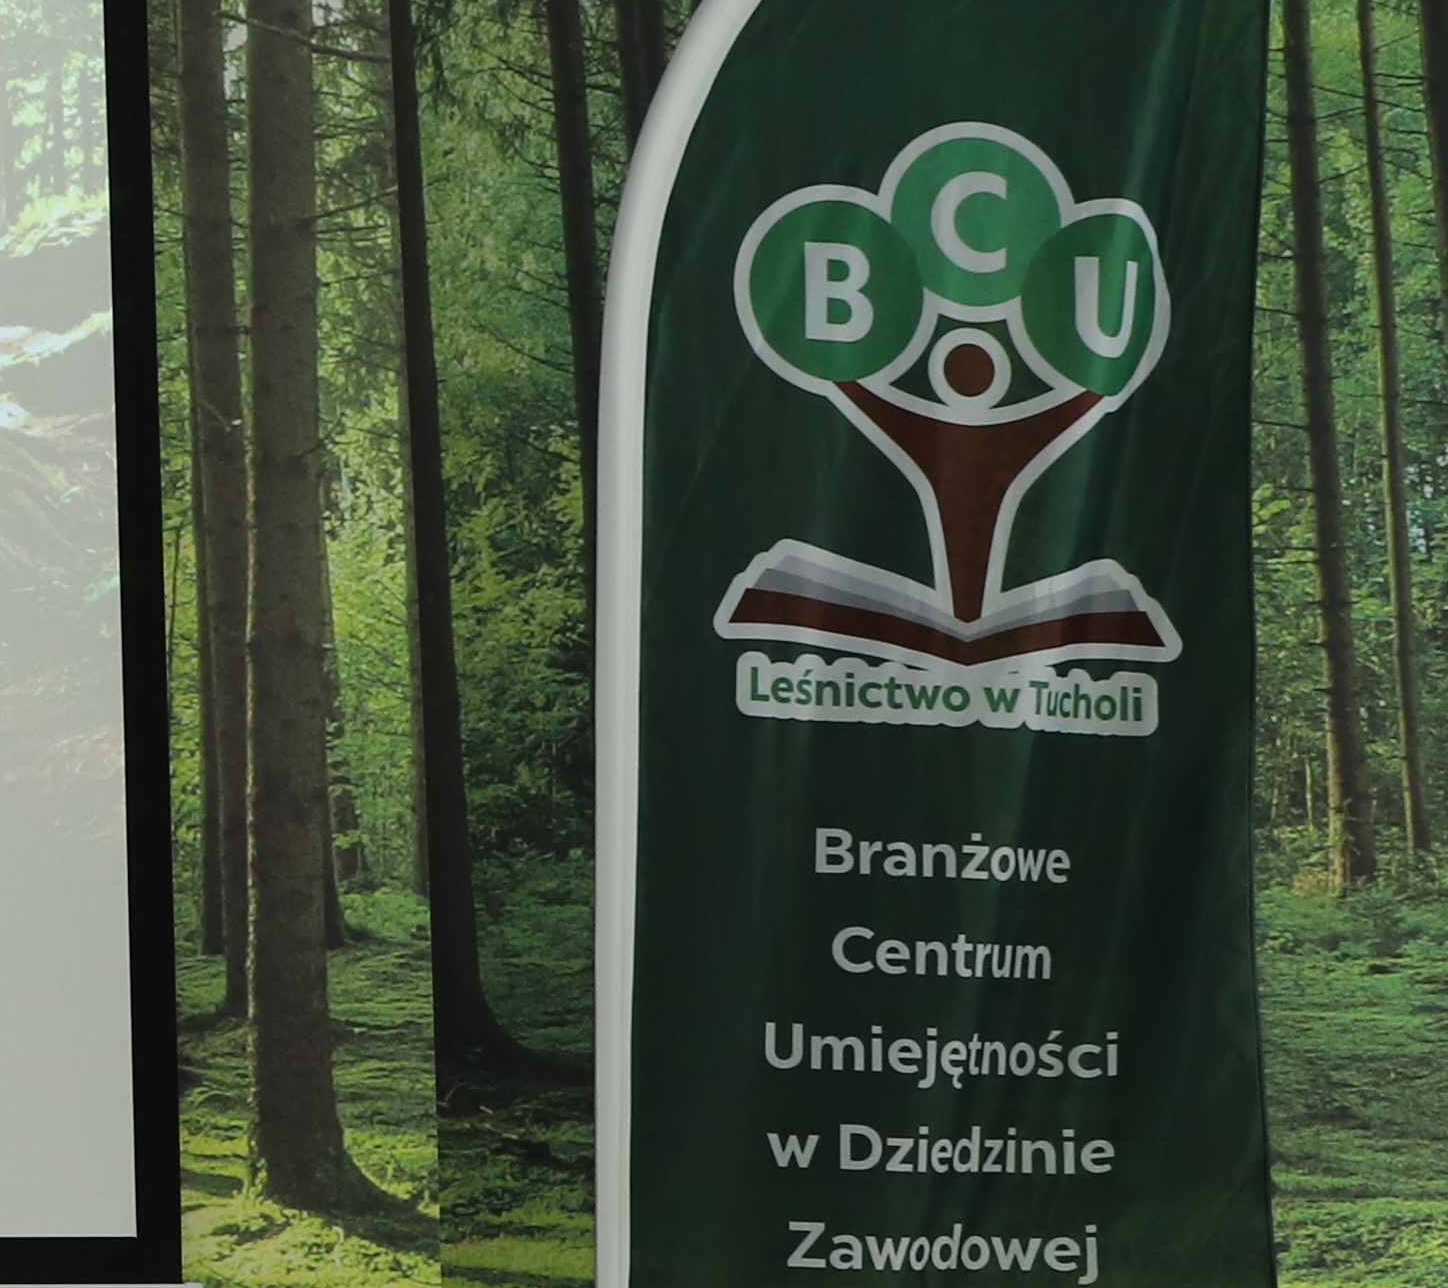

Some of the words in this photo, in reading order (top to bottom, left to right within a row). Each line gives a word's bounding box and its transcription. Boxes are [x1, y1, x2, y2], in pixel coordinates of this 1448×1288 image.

[749, 666, 971, 712] Leśnictwo
[984, 683, 1020, 714] w
[1029, 680, 1143, 722] Tucholi
[814, 827, 1071, 884] Branżowe
[831, 926, 1052, 980] Centrum
[763, 1021, 1119, 1089] Umiejętności
[766, 1132, 820, 1168] w
[838, 1123, 1115, 1175] Dziedzinie
[786, 1220, 1099, 1286] Zawodowej
